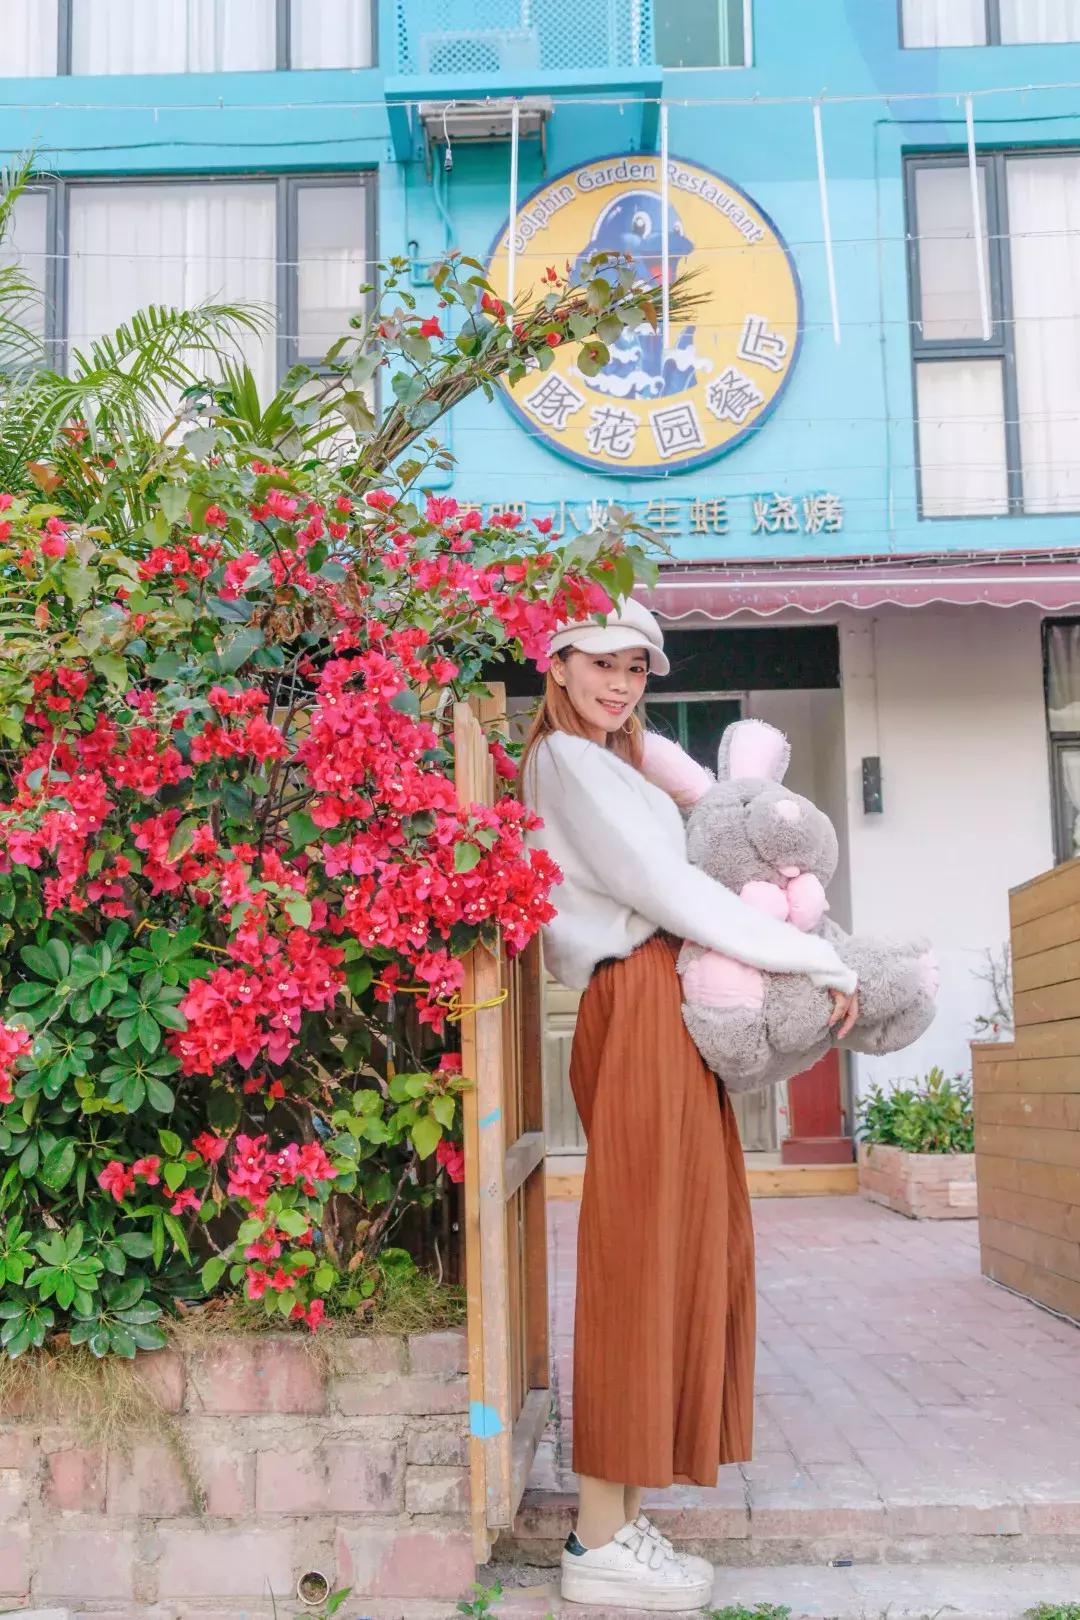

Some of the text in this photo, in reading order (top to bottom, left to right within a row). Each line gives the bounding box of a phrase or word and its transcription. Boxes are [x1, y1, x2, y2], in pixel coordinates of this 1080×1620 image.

[504, 160, 764, 253] Dolphin Garden Restaurant
[523, 315, 788, 459] 豚花园餐厅
[645, 496, 730, 534] 生蚝
[751, 491, 844, 534] 烧烤
